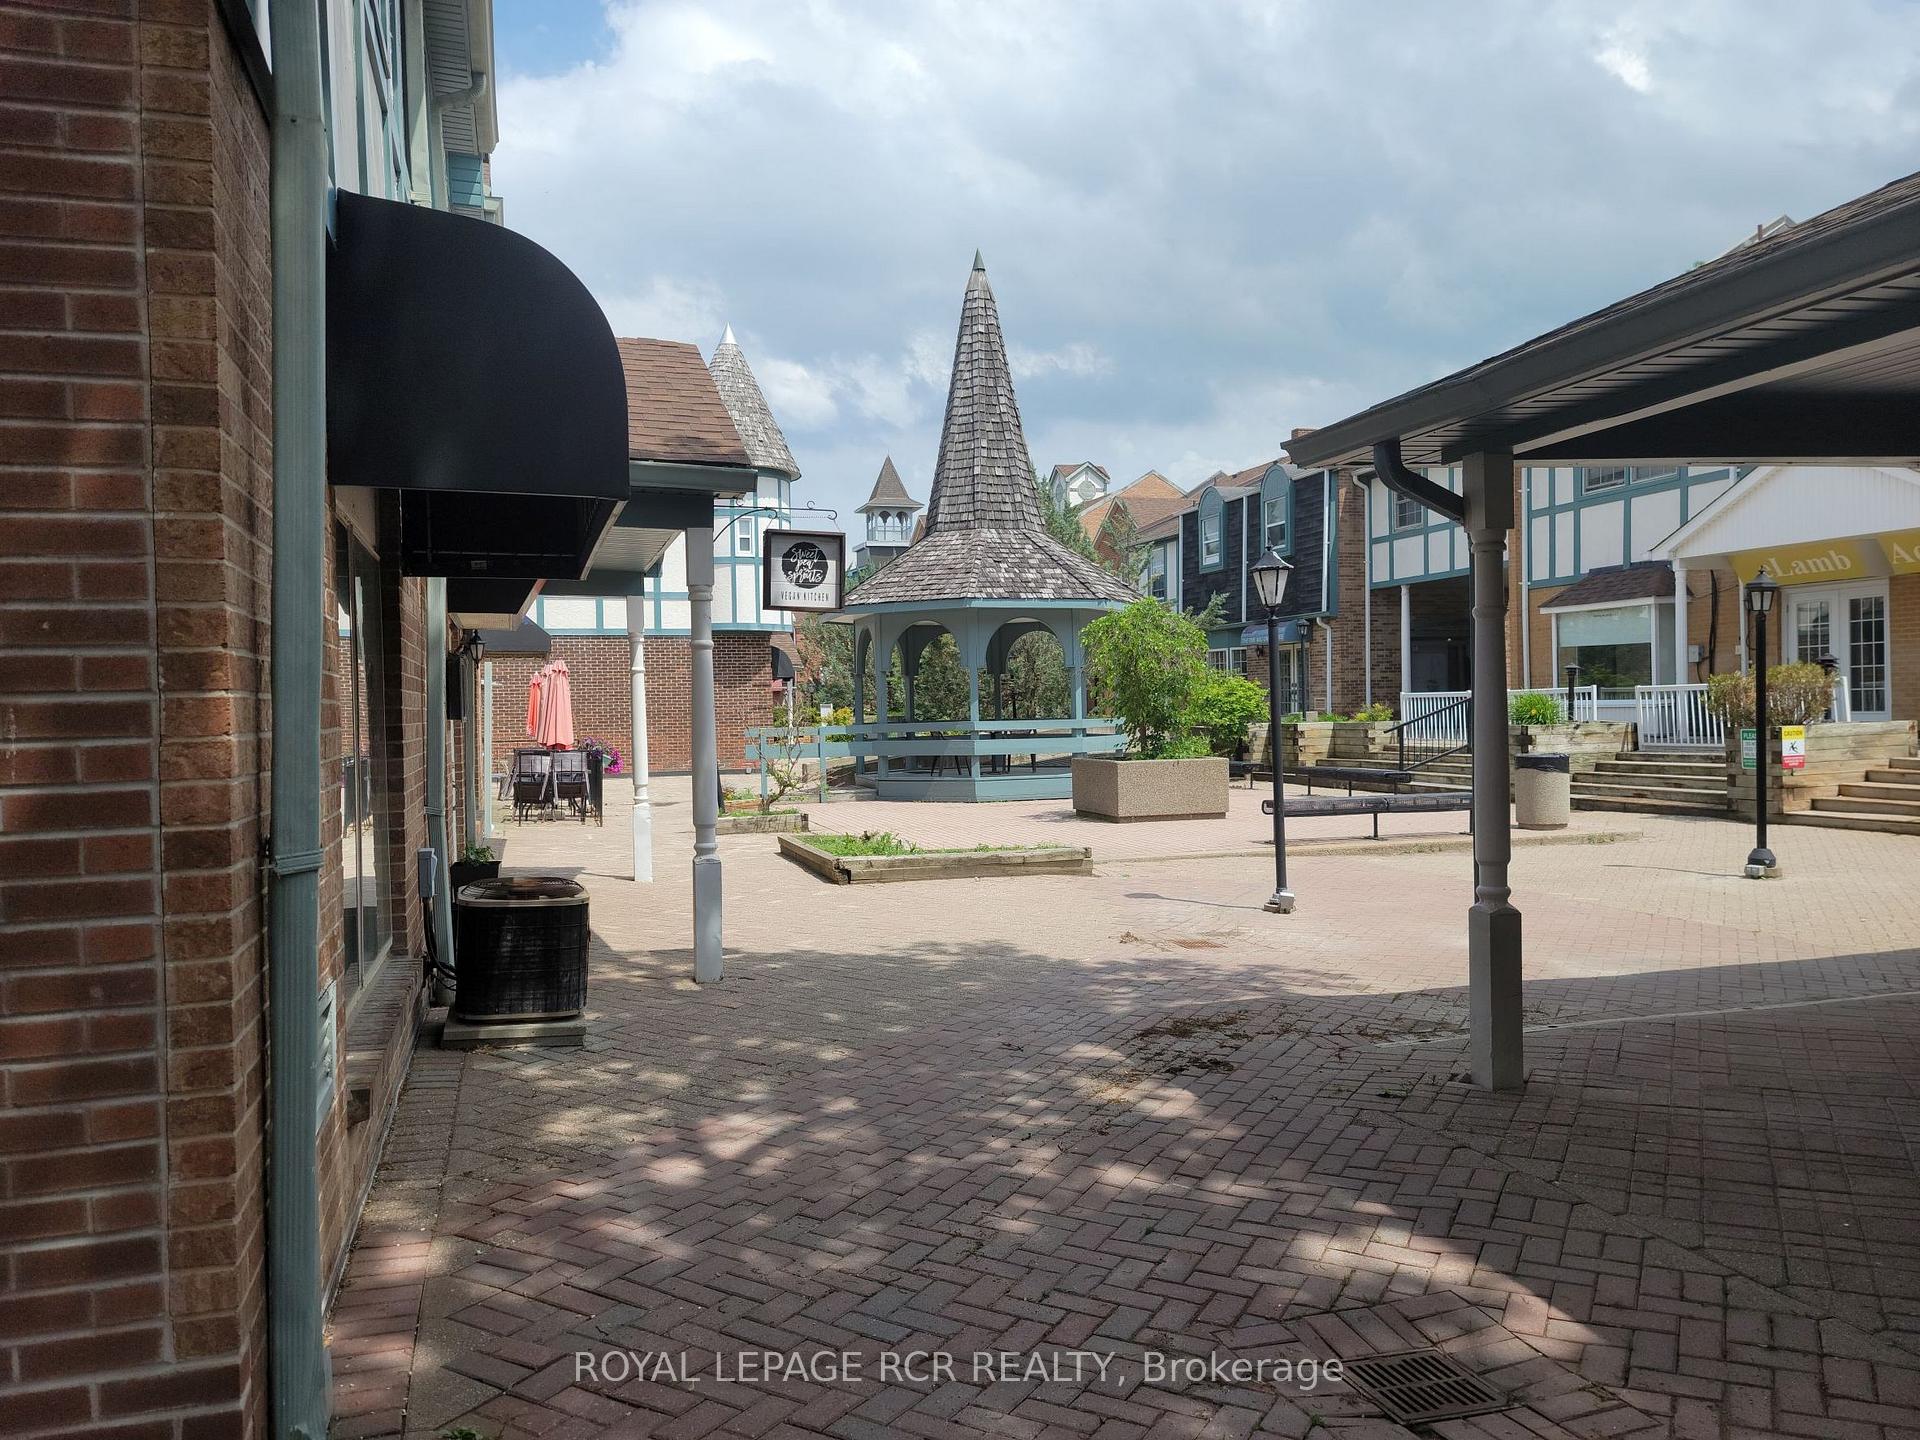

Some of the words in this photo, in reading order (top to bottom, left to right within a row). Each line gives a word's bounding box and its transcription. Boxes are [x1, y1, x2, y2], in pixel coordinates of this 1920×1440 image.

[781, 591, 800, 601] VEGAN
[803, 592, 829, 602] KITCHEN
[1743, 732, 1756, 740] PLEA
